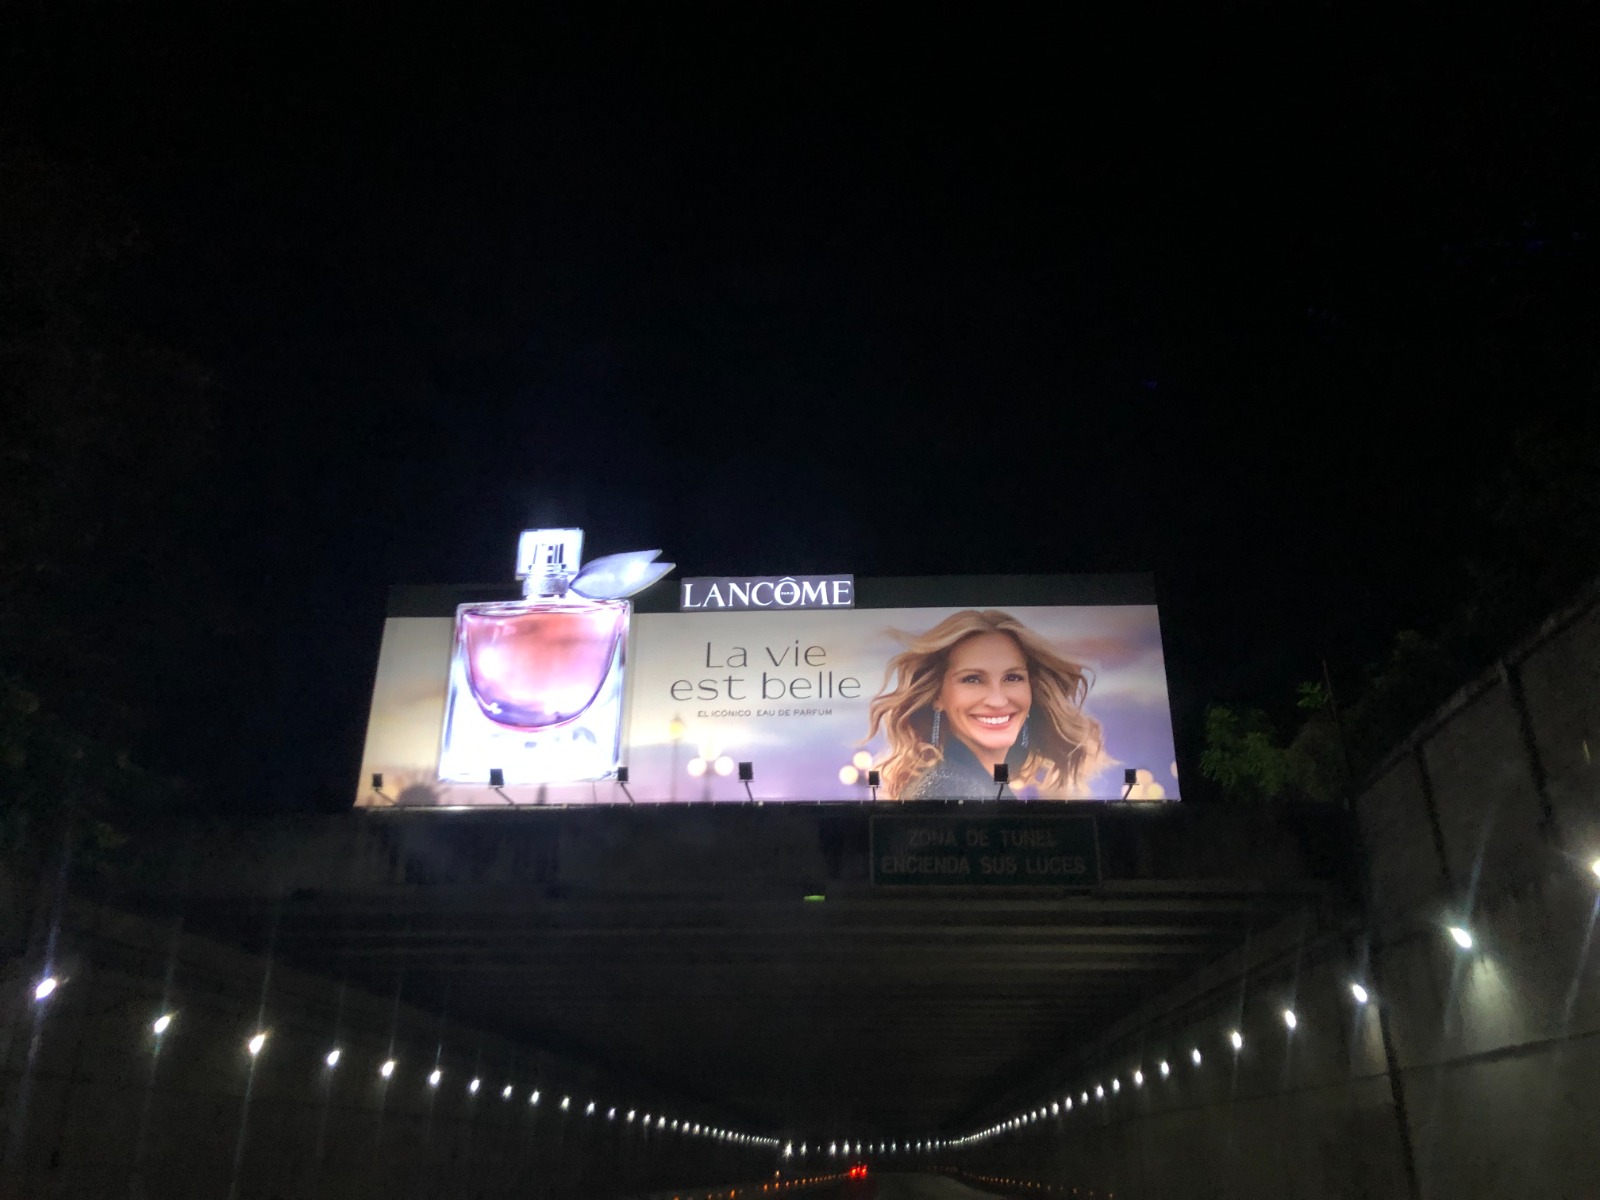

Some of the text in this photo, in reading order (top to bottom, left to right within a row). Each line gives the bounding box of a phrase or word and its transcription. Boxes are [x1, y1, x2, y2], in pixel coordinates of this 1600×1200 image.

[682, 576, 852, 608] LANCÔME
[706, 640, 827, 668] La vie
[670, 671, 861, 701] est belle
[697, 710, 709, 718] EL
[757, 709, 775, 717] EAU
[778, 709, 791, 717] DE
[794, 708, 833, 716] PARFUM
[908, 829, 958, 847] ZONA
[965, 829, 991, 847] DE
[880, 856, 1087, 875] ENCIENDA SUS LUCES
